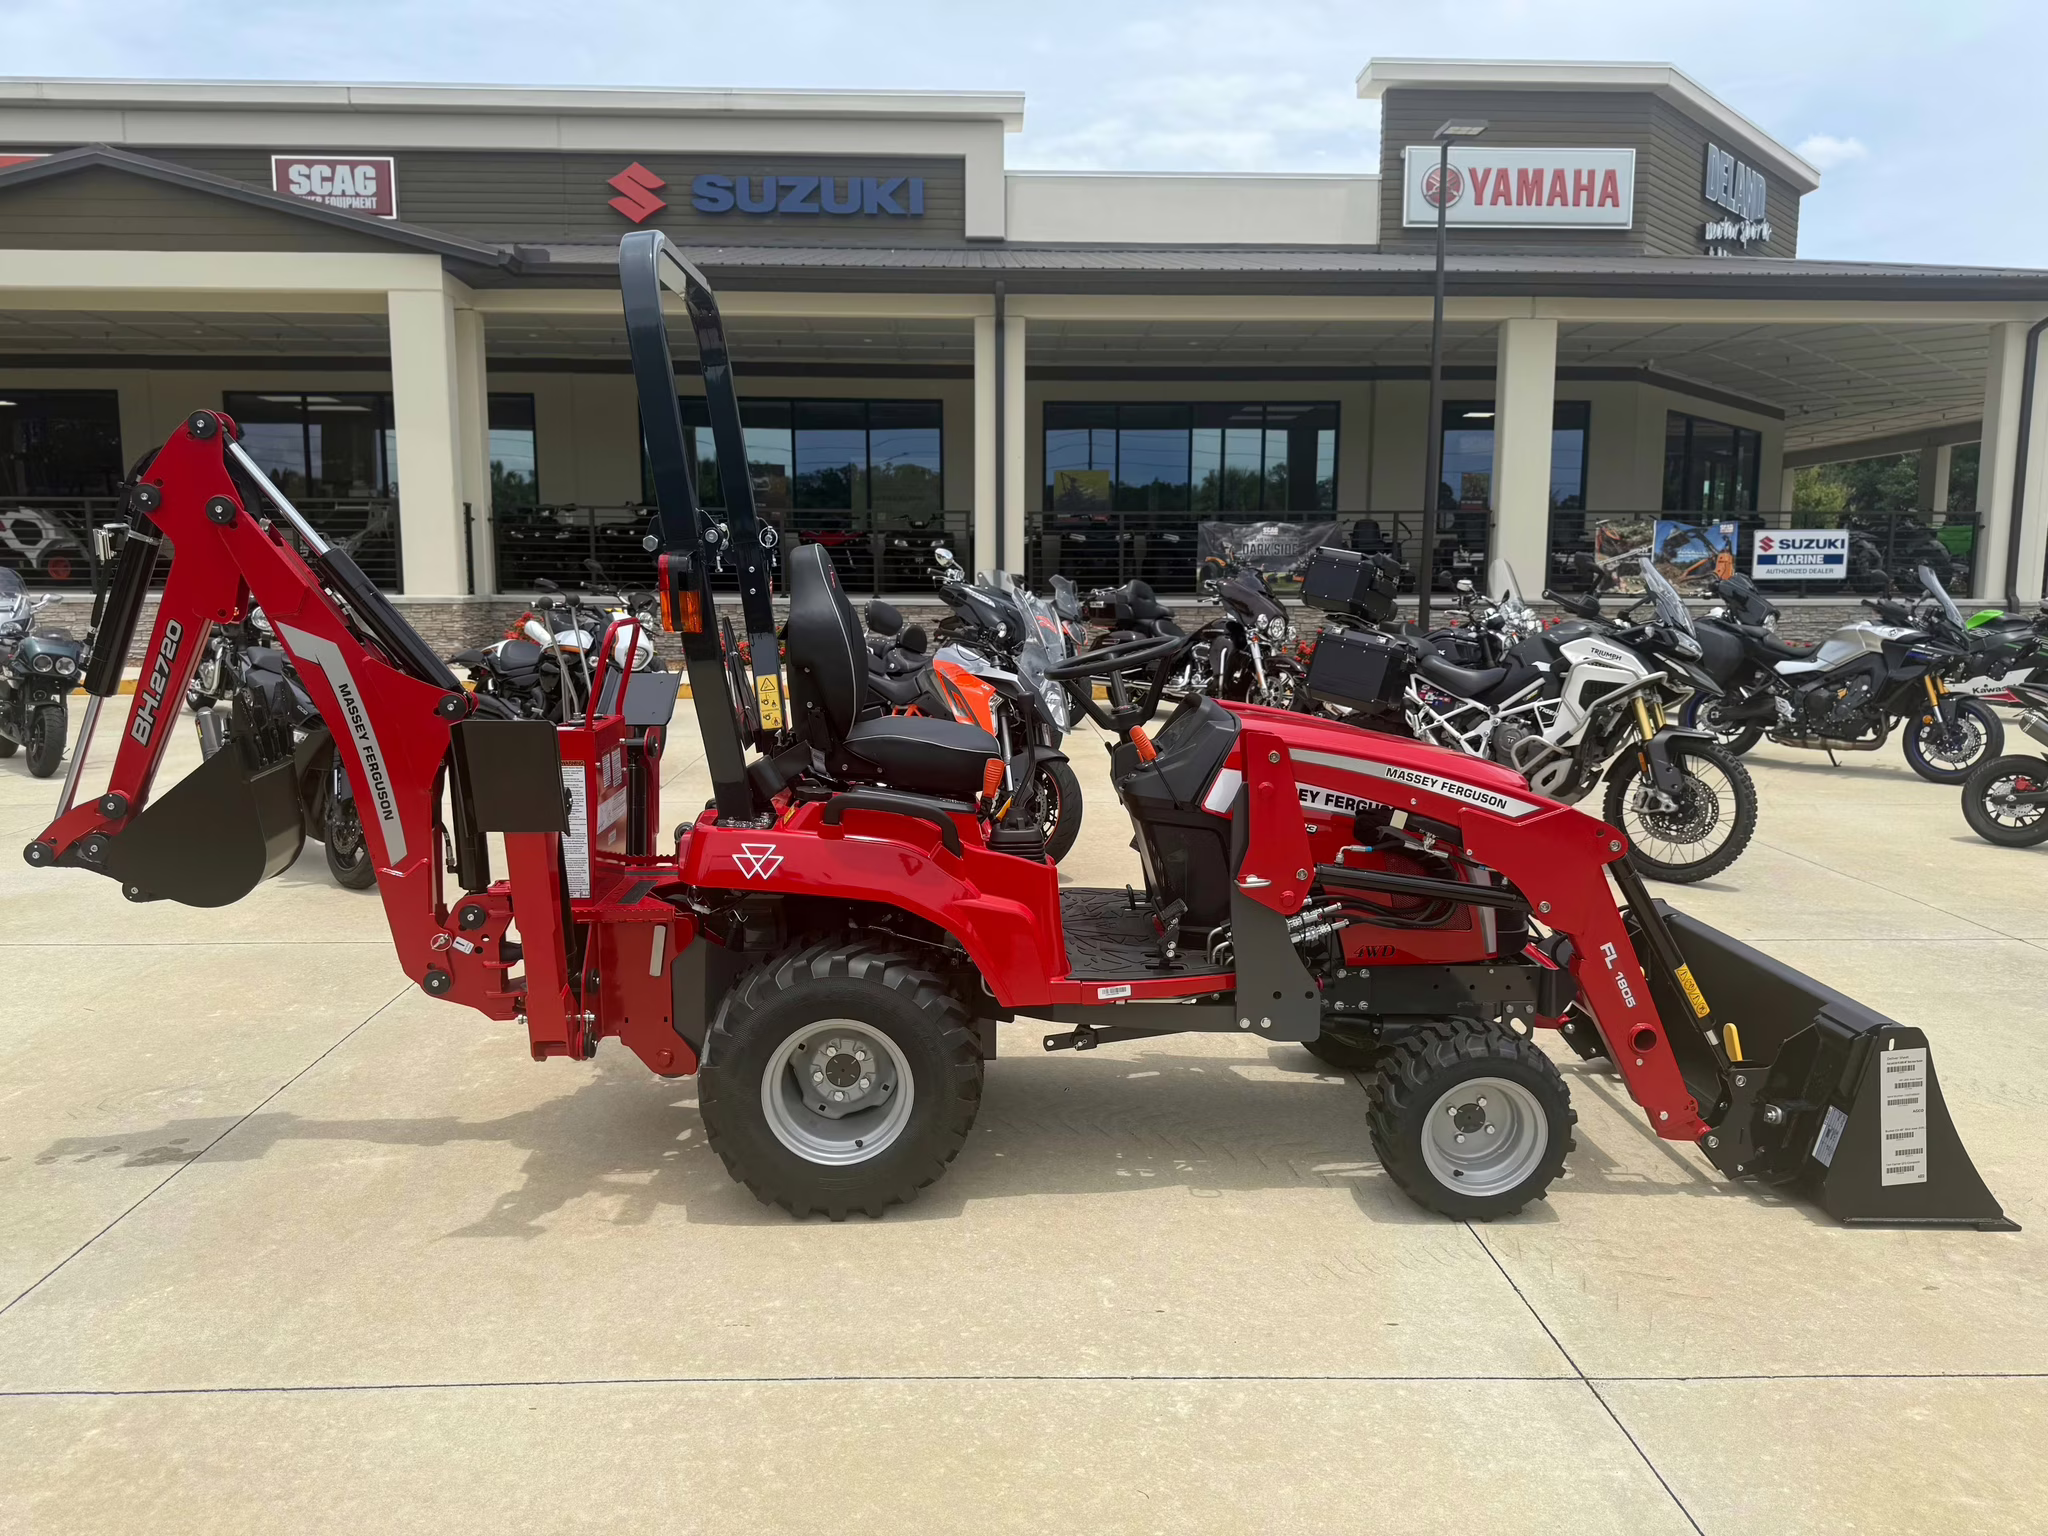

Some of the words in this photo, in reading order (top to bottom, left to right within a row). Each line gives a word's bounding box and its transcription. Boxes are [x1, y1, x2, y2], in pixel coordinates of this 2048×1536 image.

[288, 164, 377, 196] SCAG
[690, 173, 925, 216] SUZUKI
[1468, 167, 1620, 208] YAMAHA
[1705, 142, 1766, 222] DELAND
[1242, 543, 1271, 555] DARK
[1273, 543, 1298, 555] SIDE
[1776, 554, 1824, 565] MARINE
[1778, 538, 1845, 550] SUZUKI
[1590, 646, 1622, 661] TRIUMPH
[130, 618, 184, 748] BH.2720
[338, 683, 370, 741] MASSEY
[362, 745, 395, 821] FERGUSON
[1385, 767, 1439, 788] MASSEY
[1440, 781, 1508, 810] FERGUSON
[1353, 944, 1396, 958] 4WD
[1600, 941, 1618, 970] FL
[1615, 971, 1637, 1008] 1805
